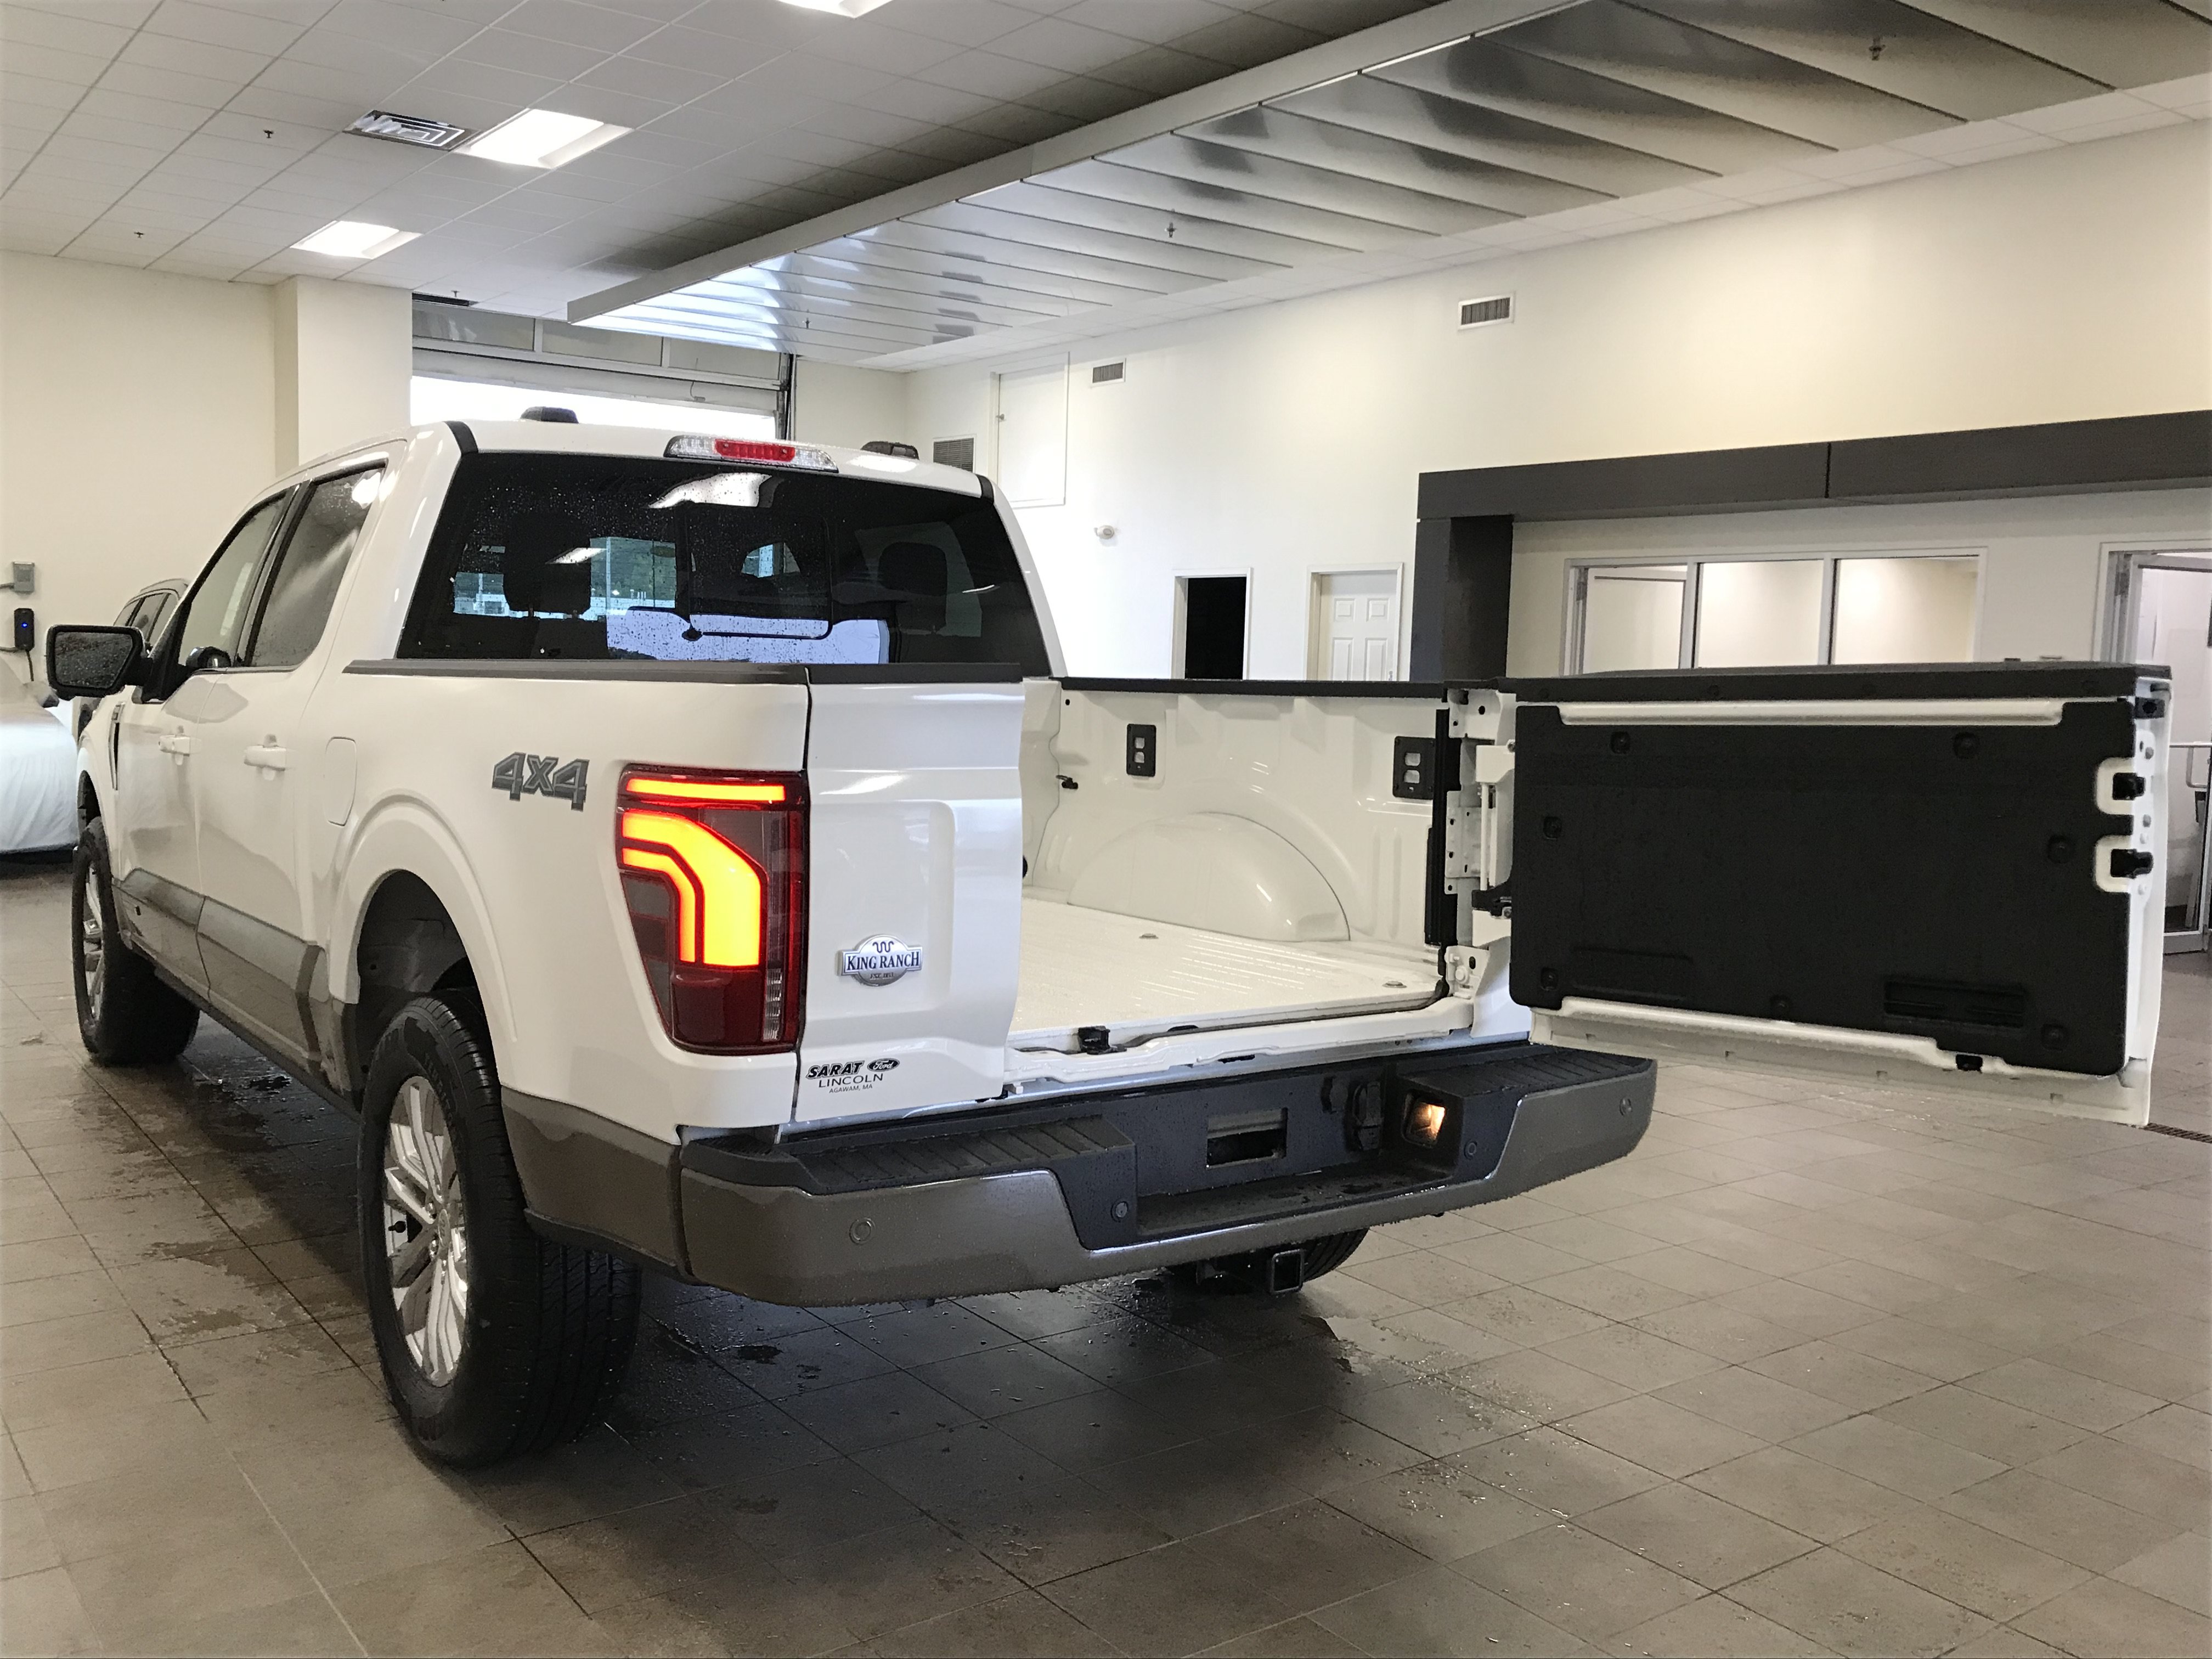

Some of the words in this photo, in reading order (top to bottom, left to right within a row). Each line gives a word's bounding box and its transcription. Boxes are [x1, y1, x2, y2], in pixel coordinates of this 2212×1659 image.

[847, 956, 877, 970] KING
[879, 951, 919, 968] RANCH
[806, 1060, 865, 1079] SARAT
[872, 1059, 895, 1070] Ford
[819, 1073, 883, 1088] LINCOLN
